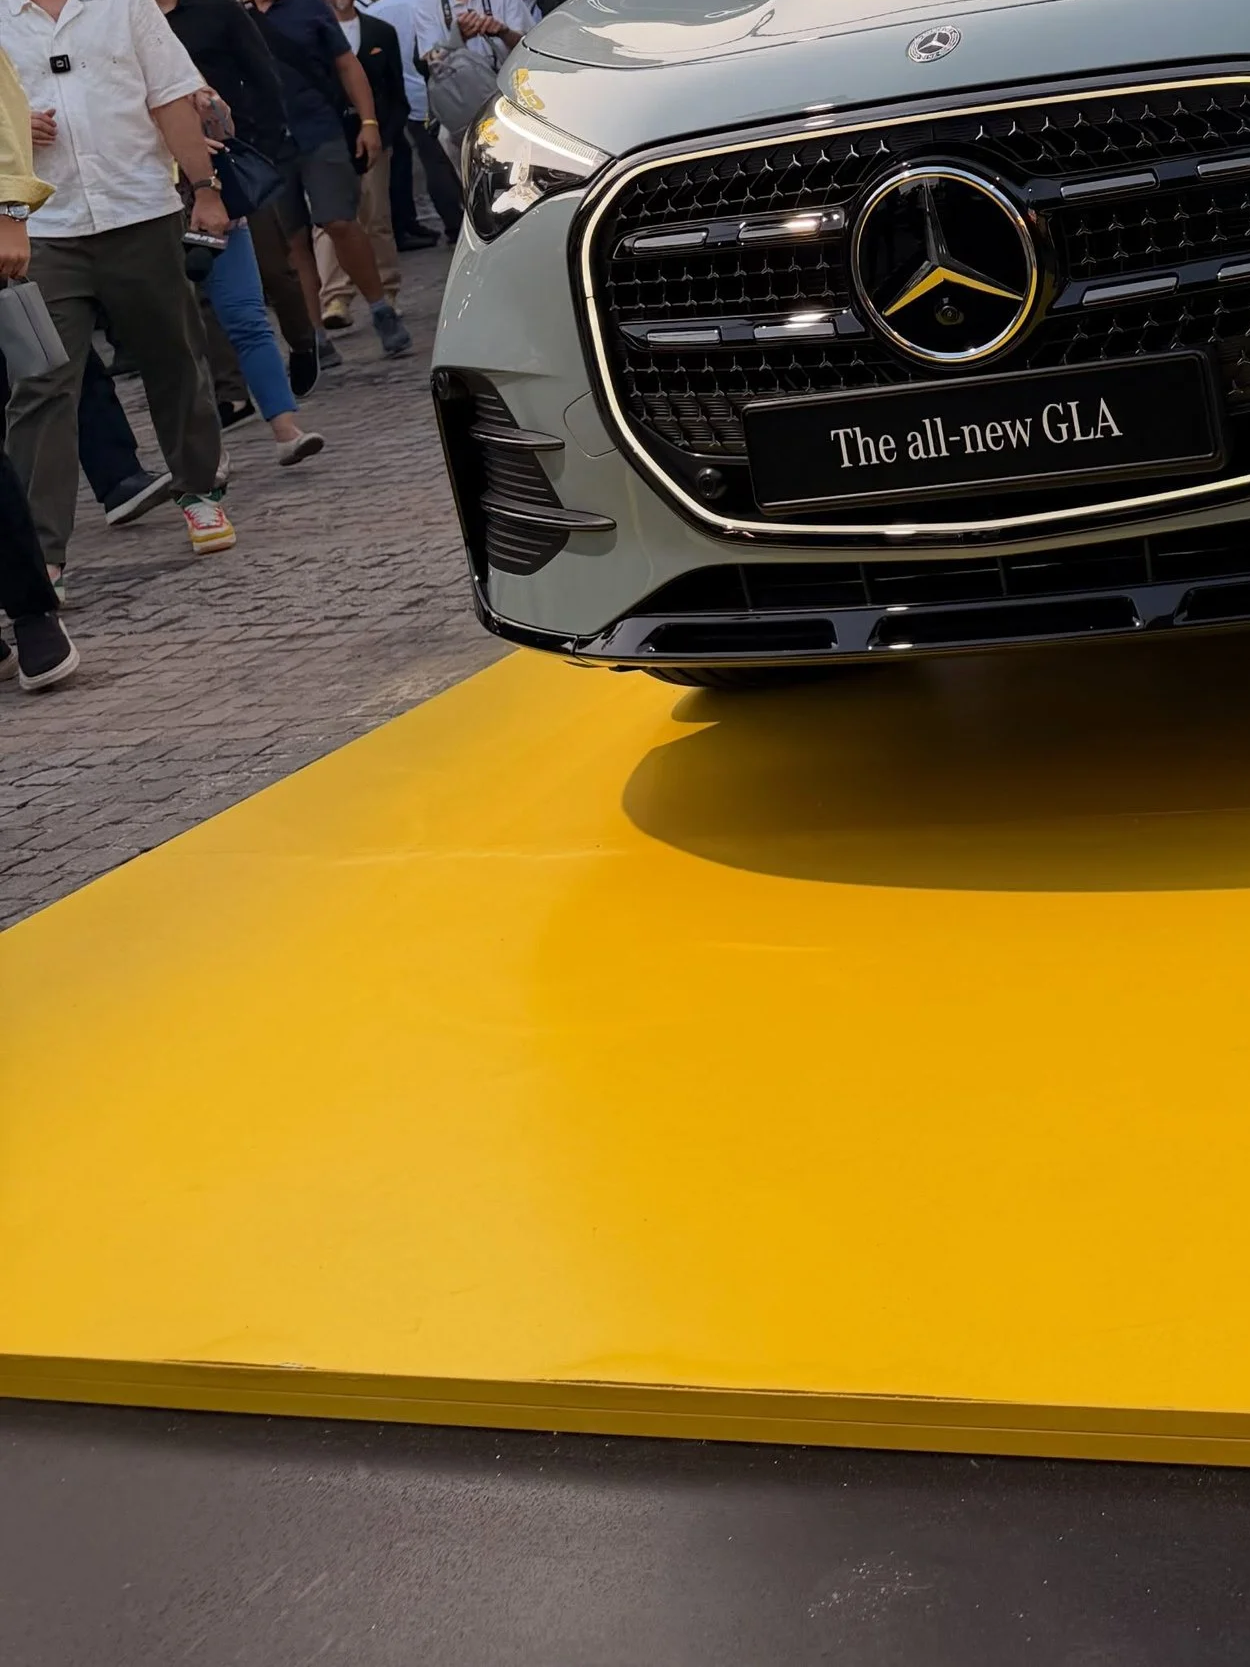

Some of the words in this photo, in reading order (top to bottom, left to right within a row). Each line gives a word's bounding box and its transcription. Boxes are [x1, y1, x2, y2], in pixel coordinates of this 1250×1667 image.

[830, 427, 897, 468] The
[907, 417, 1032, 460] all-new
[1042, 397, 1123, 443] GLA
